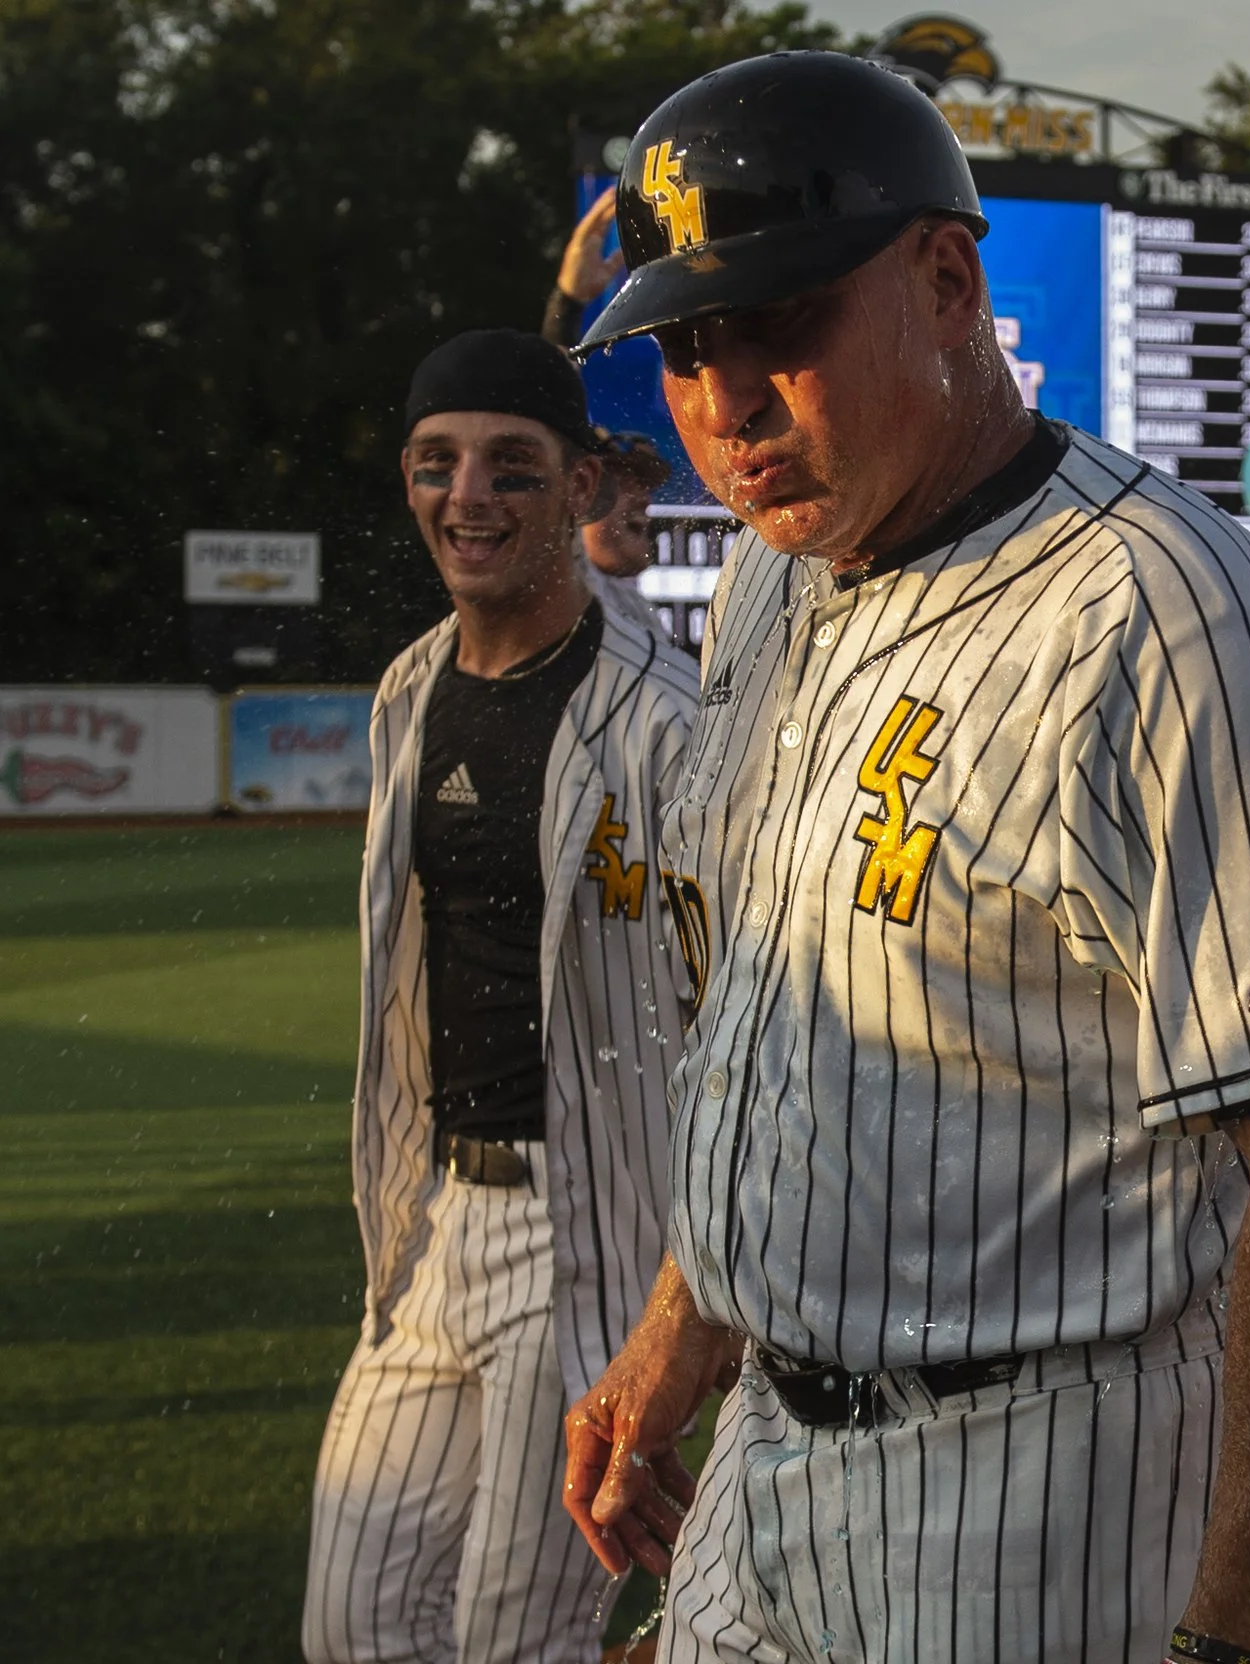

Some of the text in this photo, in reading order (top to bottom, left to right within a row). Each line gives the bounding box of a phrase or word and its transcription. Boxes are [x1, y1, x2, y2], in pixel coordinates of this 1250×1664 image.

[641, 137, 709, 254] USM
[436, 787, 479, 805] adidas
[854, 693, 945, 927] USM
